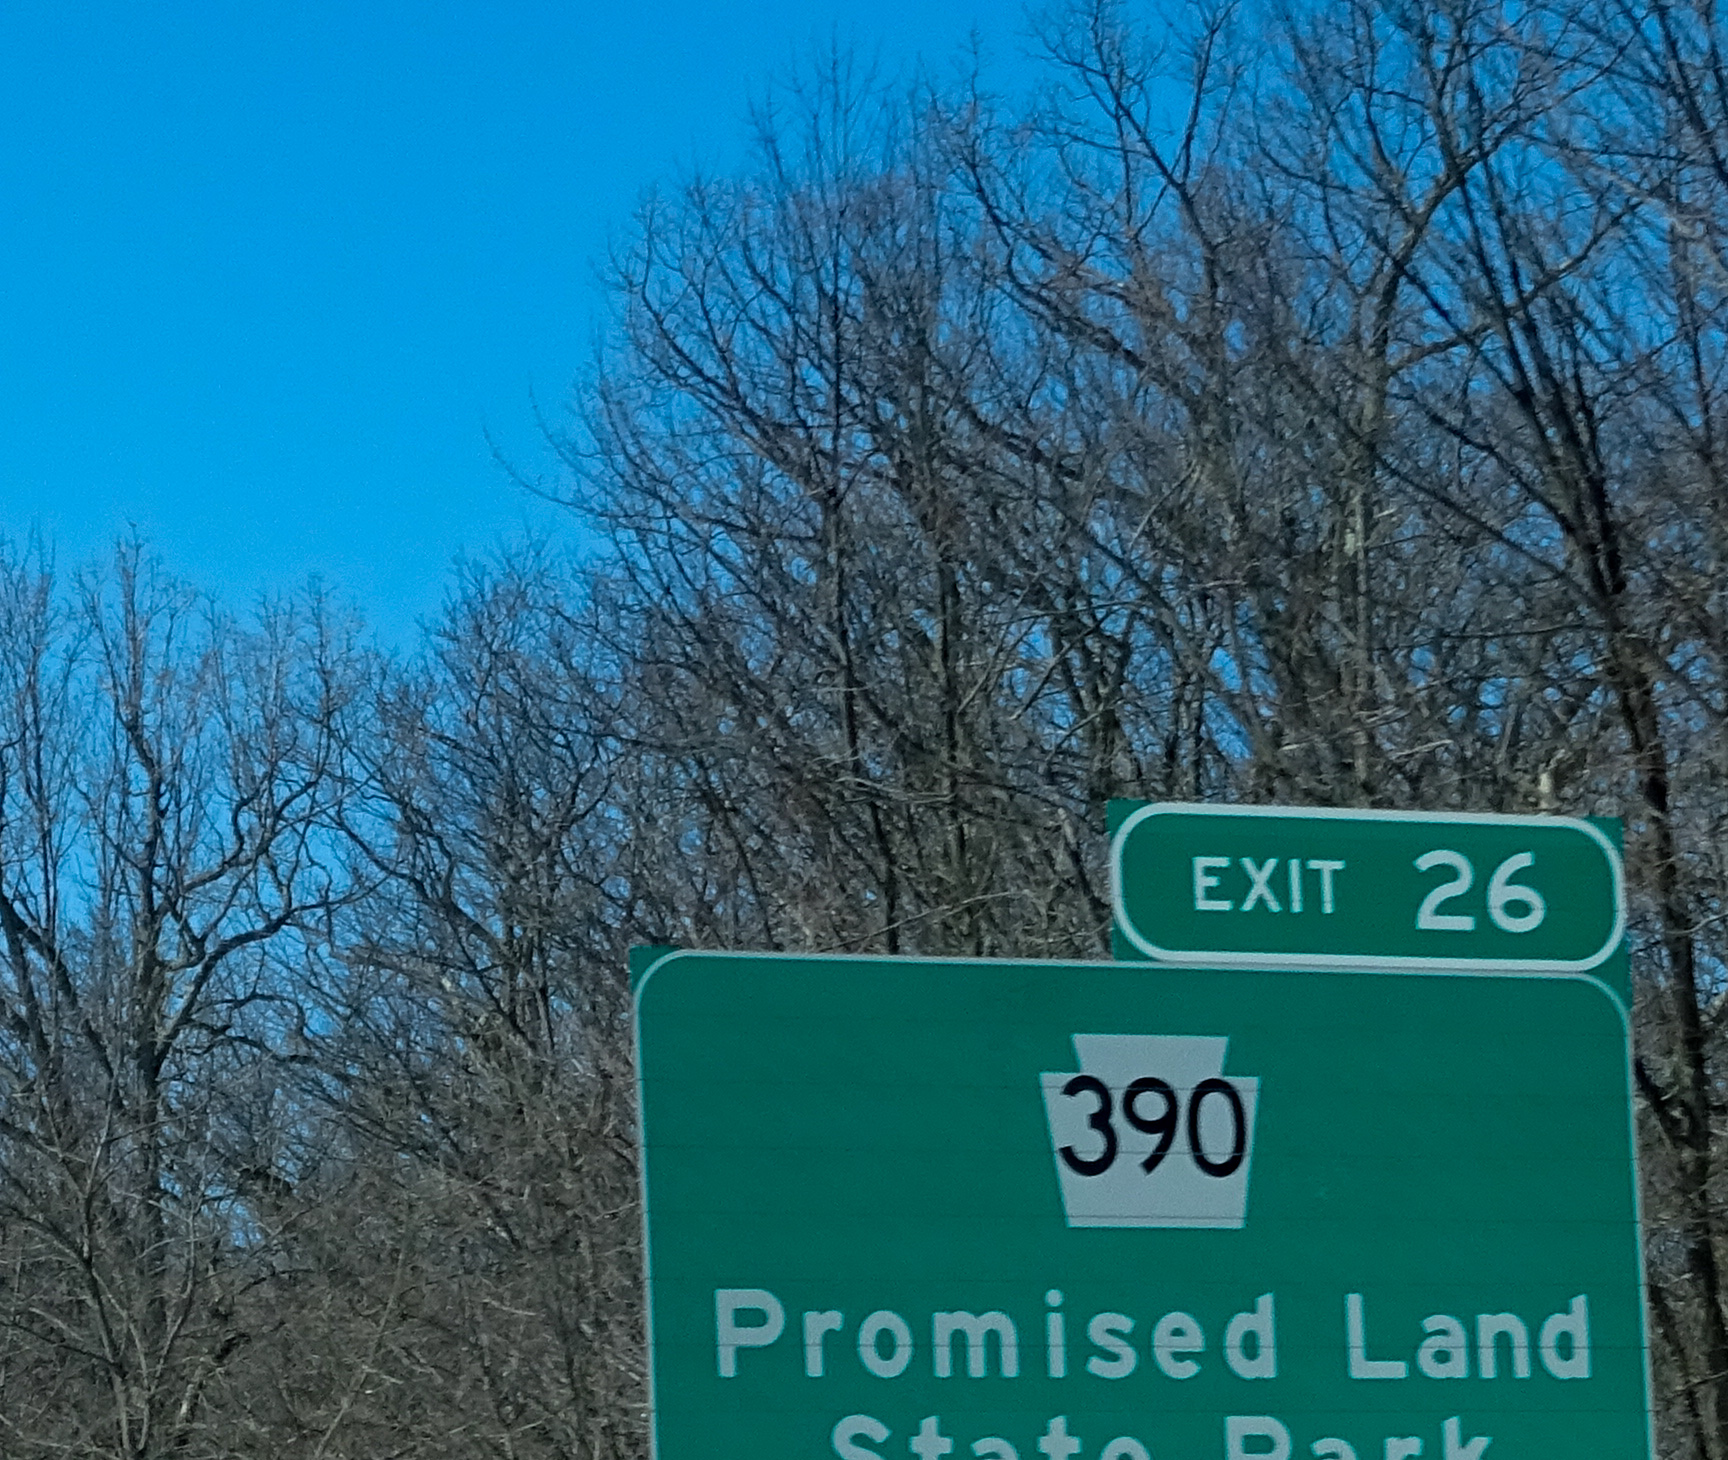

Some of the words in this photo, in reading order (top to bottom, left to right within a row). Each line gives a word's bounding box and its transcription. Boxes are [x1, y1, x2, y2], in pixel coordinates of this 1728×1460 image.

[1192, 856, 1346, 914] EXIT
[1414, 850, 1548, 932] 26
[1058, 1074, 1248, 1178] 390
[714, 1288, 1277, 1380] Promised
[1345, 1292, 1593, 1381] Land
